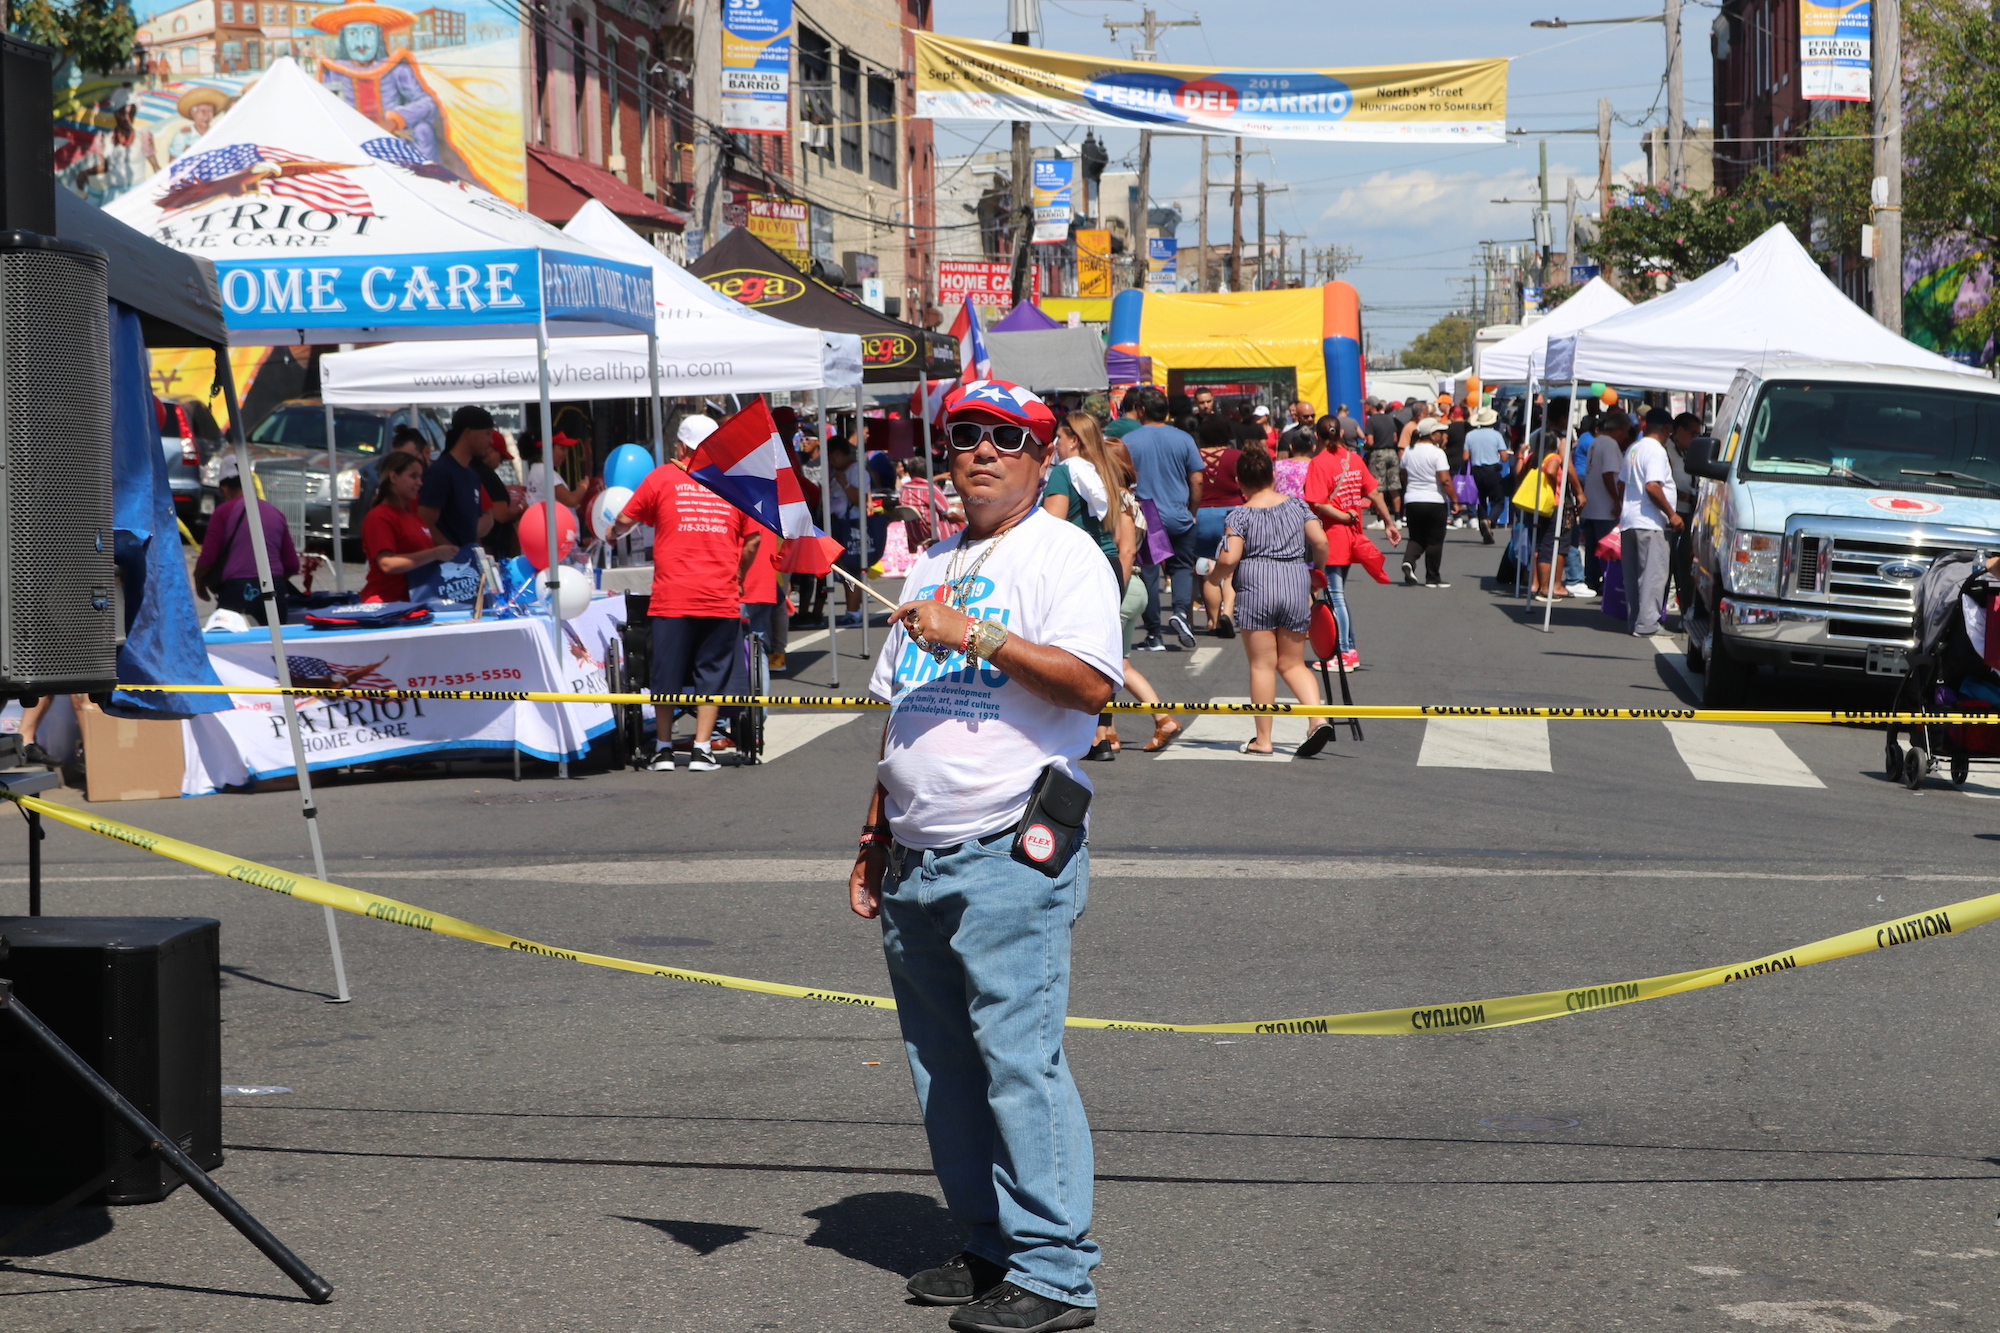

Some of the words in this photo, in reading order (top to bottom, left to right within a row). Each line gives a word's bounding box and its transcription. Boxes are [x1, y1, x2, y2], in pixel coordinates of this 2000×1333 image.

[729, 9, 752, 17] years
[753, 9, 764, 17] of
[1804, 12, 1869, 20] Celebrando
[728, 16, 779, 26] Celebrating
[1804, 20, 1869, 28] Comunidad
[728, 23, 779, 33] Community
[726, 43, 789, 54] Celebrando
[1808, 40, 1839, 48] FERIA
[1842, 41, 1862, 49] DEL
[726, 51, 789, 61] Comunidad
[1808, 48, 1862, 57] BARRIO
[999, 62, 1057, 80] Domingo
[728, 73, 757, 81] FERIA
[761, 74, 780, 82] DEL
[928, 68, 960, 82] Sept.
[963, 70, 975, 82] 8,
[1013, 76, 1025, 86] 12
[728, 80, 780, 91] BARRIO
[1248, 78, 1290, 89] 2019
[1376, 86, 1410, 98] North
[1428, 86, 1464, 98] Street
[1096, 84, 1174, 108] FERIA
[1183, 89, 1235, 112] DEL
[1241, 90, 1348, 114] BARRIO
[1360, 101, 1427, 112] HUNTINGDON
[1430, 102, 1442, 112] TO
[1443, 101, 1494, 112] SOMERSET
[1036, 163, 1055, 174] 35
[779, 203, 806, 219] ANKLE
[750, 219, 796, 234] DOCTOR
[232, 232, 331, 248] CARE
[1150, 239, 1164, 248] 35
[941, 263, 990, 273] HUMBLE
[940, 274, 988, 290] HOME
[221, 268, 348, 314] OME
[360, 262, 527, 314] CARE
[544, 262, 597, 311] PATRIOT
[592, 265, 628, 313] HOME
[624, 273, 656, 320] CARE
[674, 483, 698, 492] VITAL
[406, 668, 523, 688] 877-535-5550
[941, 684, 992, 699] development
[938, 695, 952, 707] art,
[954, 697, 969, 707] and
[970, 699, 1000, 711] culture
[269, 696, 427, 739] PATRIOT
[909, 703, 952, 717] Philadelphia
[953, 708, 975, 719] since
[978, 709, 1000, 721] 1979
[302, 732, 351, 753] HOME
[355, 722, 411, 744] CARE
[1027, 835, 1051, 846] FLEX
[1876, 911, 1952, 949] CAUTION
